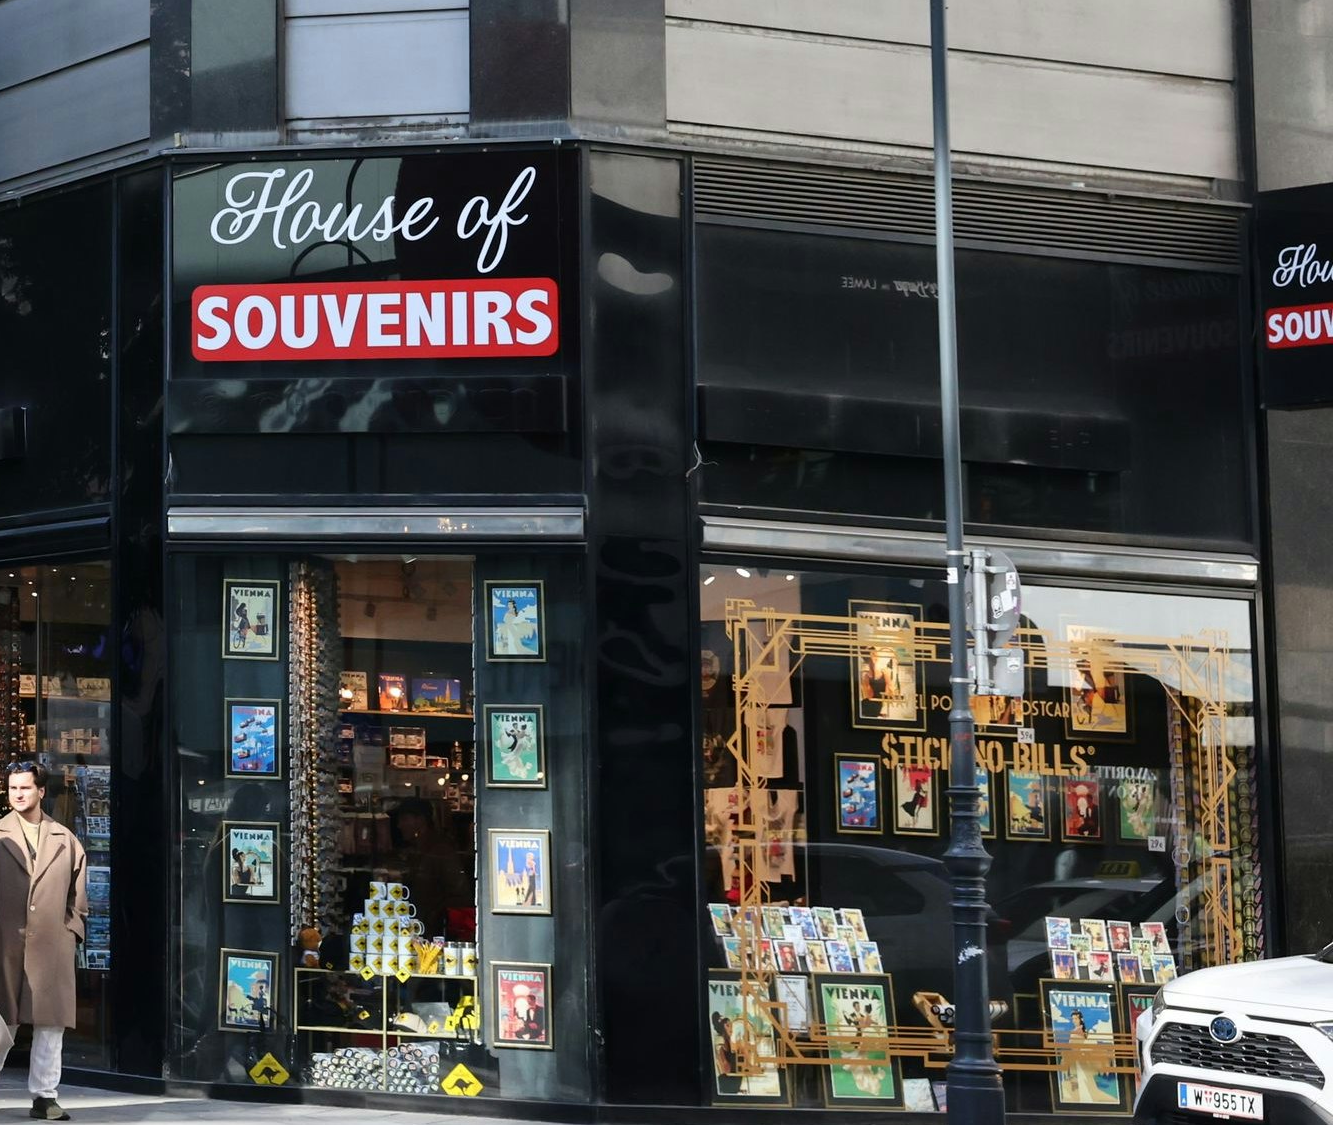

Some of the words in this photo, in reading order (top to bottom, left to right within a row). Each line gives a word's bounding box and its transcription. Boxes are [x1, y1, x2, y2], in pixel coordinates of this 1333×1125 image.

[210, 168, 438, 249] House
[456, 166, 537, 274] of
[1272, 243, 1333, 288] Hou
[196, 287, 553, 351] SOUVENIRS
[1268, 308, 1333, 344] SOUV
[233, 588, 271, 598] VIENNA
[493, 589, 535, 599] VIENNA
[493, 714, 534, 724] VIENNA
[974, 739, 1004, 774] NO
[233, 831, 271, 842] VIENNA
[498, 838, 540, 850] VIENNA
[230, 958, 270, 971] VIENNA
[500, 971, 542, 983] VIENNA
[709, 983, 767, 998] VIENA
[825, 986, 882, 1001] VIENNA
[1053, 993, 1108, 1009] VIENNA
[1132, 996, 1154, 1010] VIE
